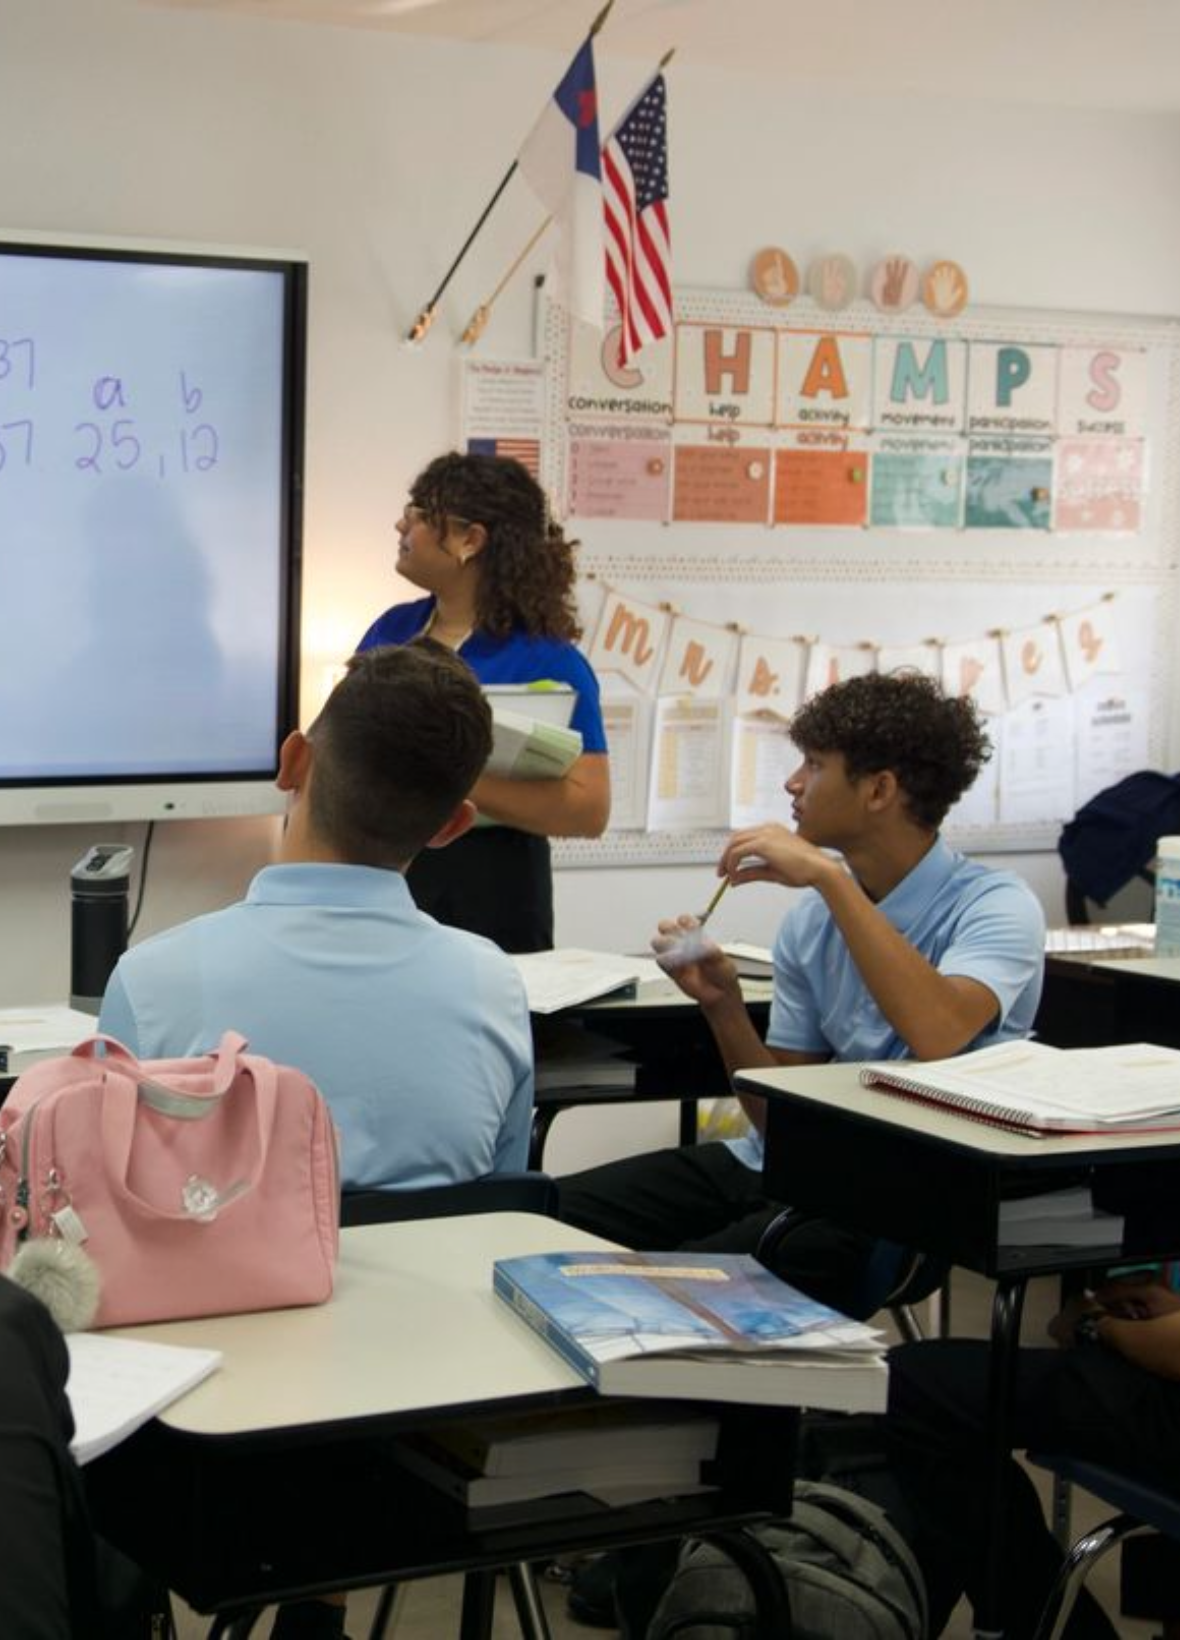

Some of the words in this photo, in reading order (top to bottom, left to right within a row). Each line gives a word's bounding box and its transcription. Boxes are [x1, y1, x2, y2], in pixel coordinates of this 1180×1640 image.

[93, 376, 126, 411] a
[180, 371, 202, 413] b
[569, 397, 673, 414] conversation
[882, 413, 955, 427] movement
